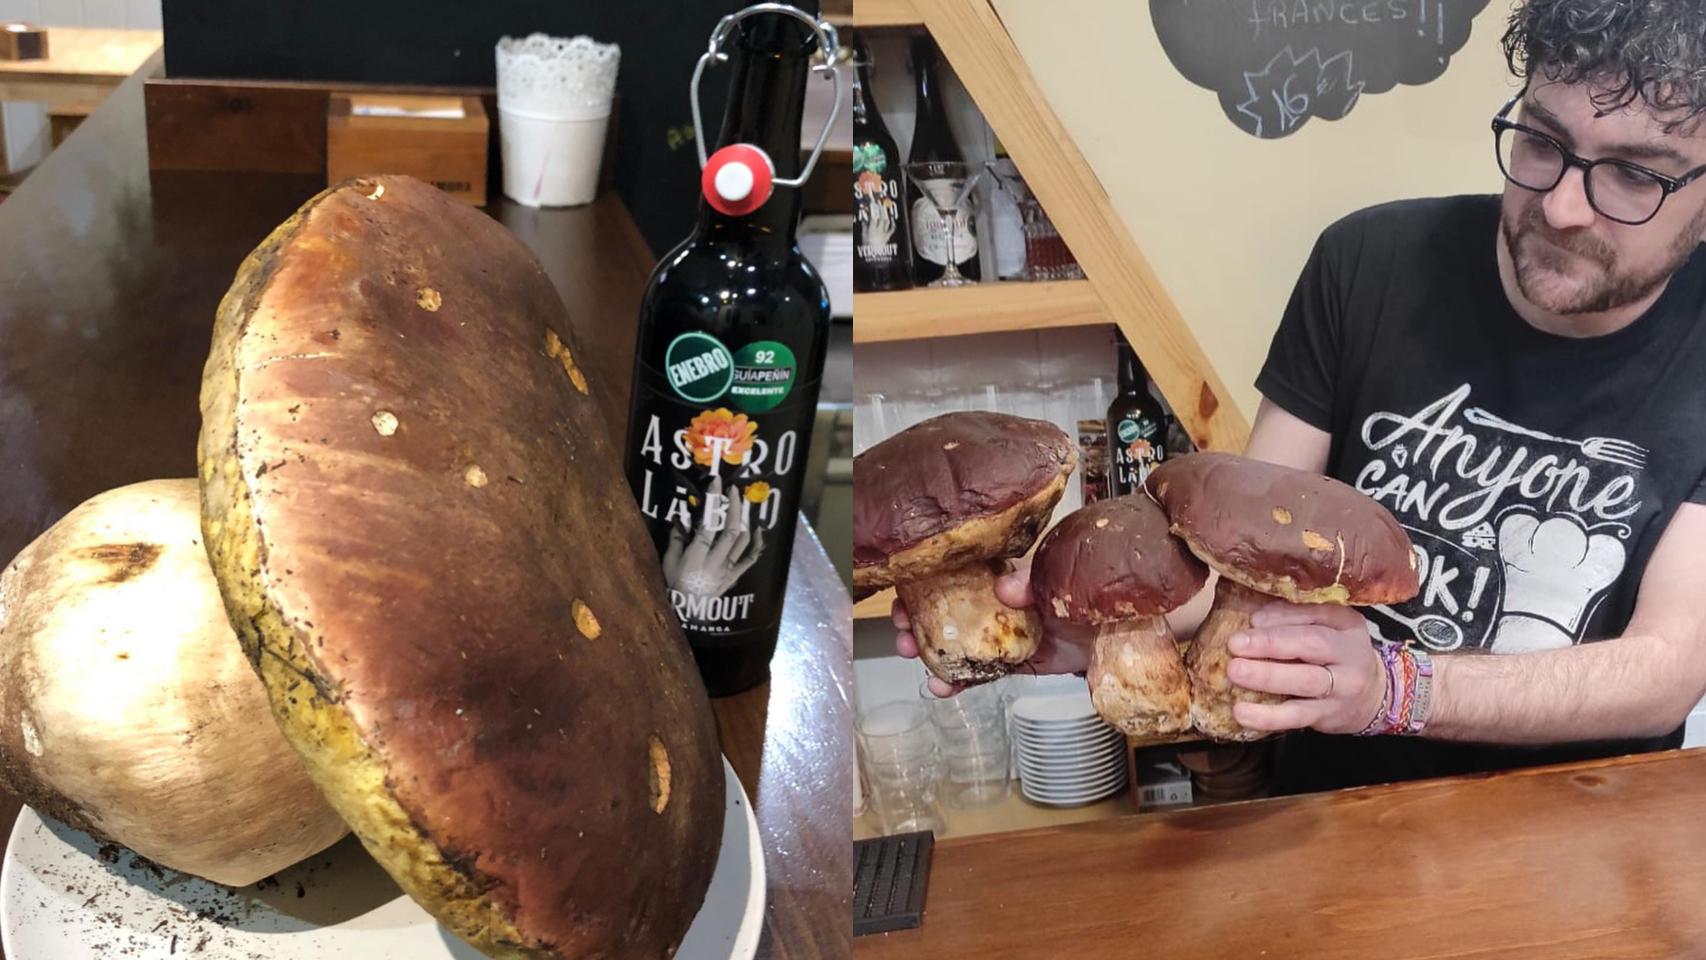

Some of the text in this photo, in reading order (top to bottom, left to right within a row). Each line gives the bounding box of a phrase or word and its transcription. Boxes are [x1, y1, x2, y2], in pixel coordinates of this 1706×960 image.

[853, 179, 898, 199] STRO
[669, 347, 729, 388] ENEBRO
[755, 350, 776, 364] 92
[730, 386, 785, 396] EXCELENTE
[640, 413, 797, 479] ASTRO
[1116, 444, 1164, 465] ASTRO
[1361, 382, 1643, 531] Anyone
[1355, 459, 1450, 521] CAN
[667, 588, 755, 622] RMOUT
